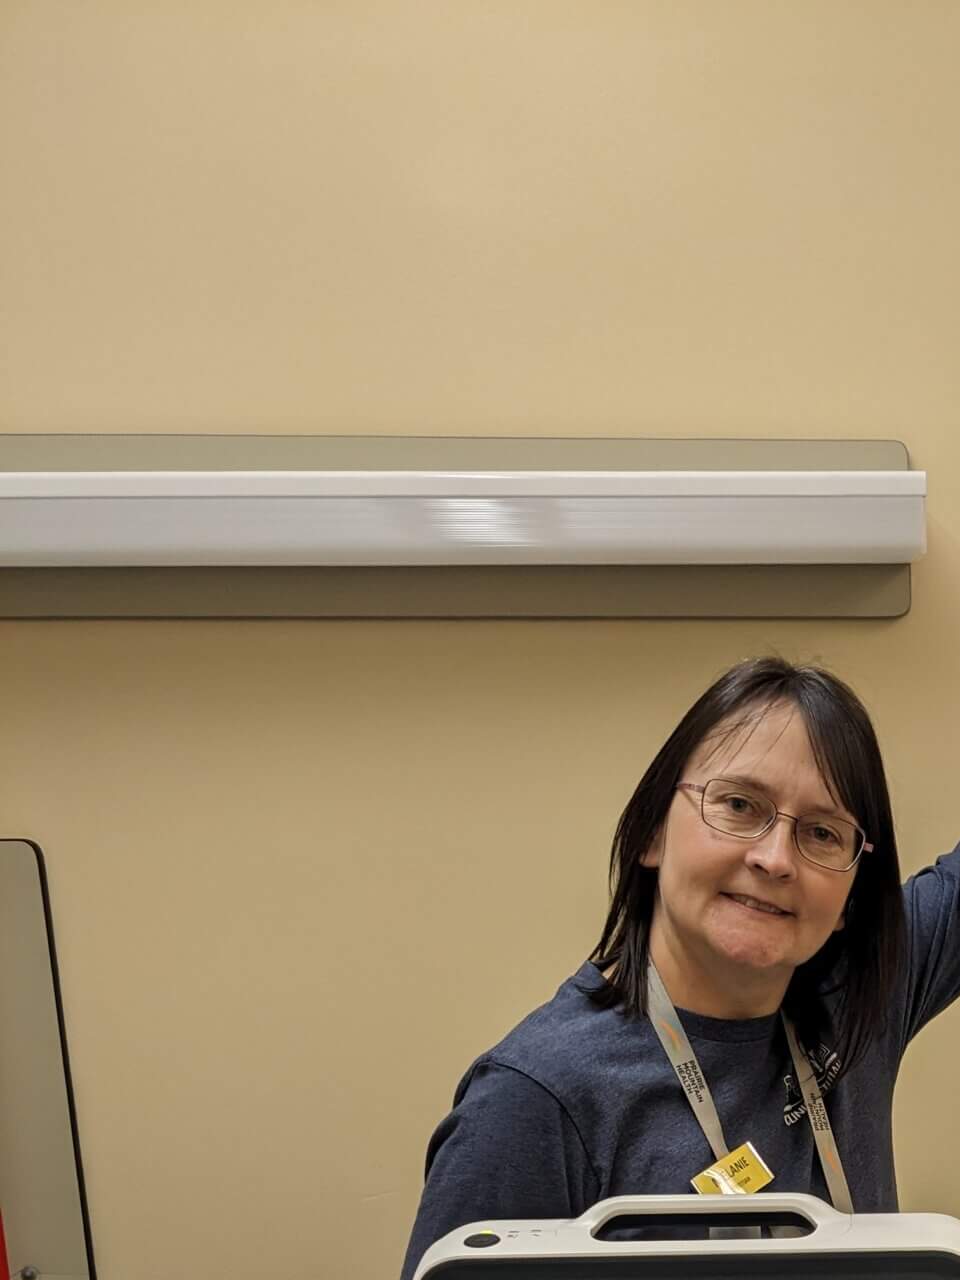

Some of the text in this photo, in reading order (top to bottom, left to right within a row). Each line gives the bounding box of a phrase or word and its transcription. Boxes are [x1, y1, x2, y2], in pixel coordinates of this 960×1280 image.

[676, 1065, 693, 1094] HEALTH
[682, 1062, 704, 1103] MOUNTAIN
[687, 1060, 705, 1090] PRAIRIE
